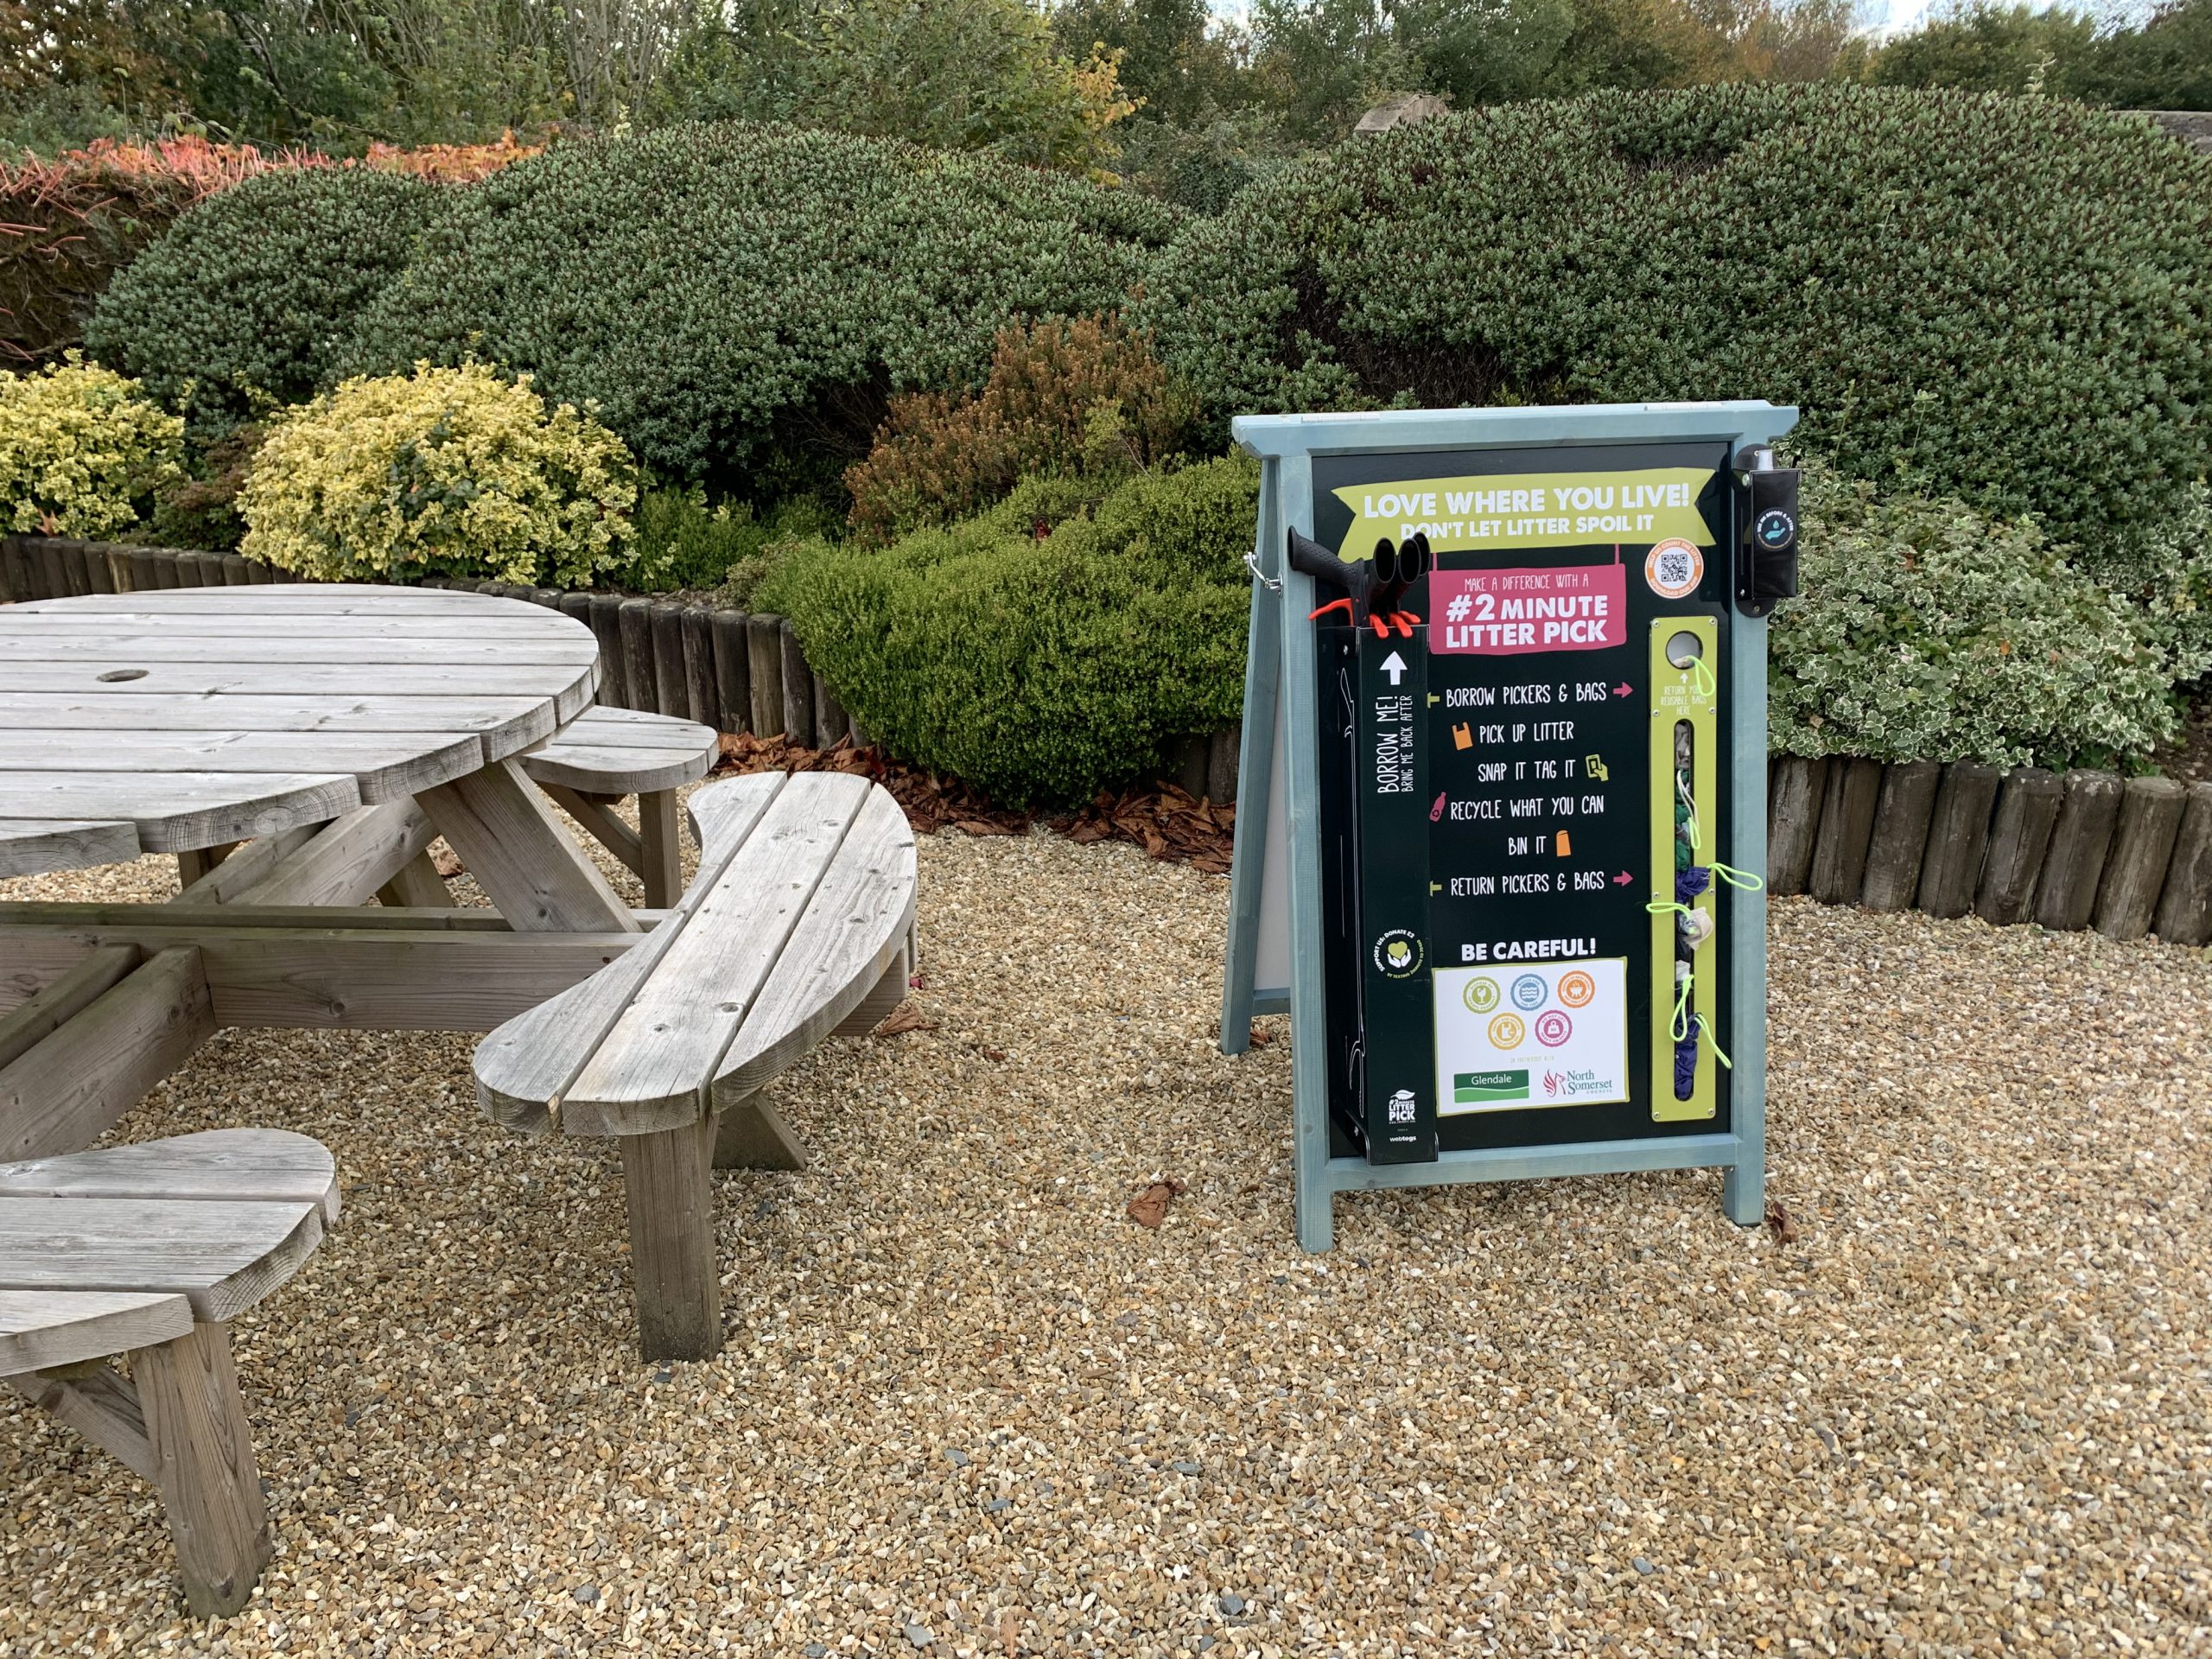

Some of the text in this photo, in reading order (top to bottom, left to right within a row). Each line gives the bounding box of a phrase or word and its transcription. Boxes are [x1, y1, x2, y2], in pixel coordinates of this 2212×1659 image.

[1364, 483, 1689, 518] LOVE WHERE YOU LIVE!
[1401, 515, 1654, 540] DON'T LET LITTER SPOIL IT
[1465, 573, 1589, 592] MAKE A DIFFERENCE WITH A
[1446, 594, 1608, 622] #2 MINUTE
[1446, 620, 1608, 648] LITTER PICK
[1446, 682, 1607, 707] BORROW PICKERS & BAGS
[1376, 696, 1399, 793] BORROW ME!
[1400, 695, 1414, 792] BRING ME BACK AFTER
[1479, 721, 1574, 744] PICK UP LITTER
[1478, 760, 1576, 782] SNAP IT TAG IT
[1451, 795, 1604, 820] RECYCLE WHAT YOU CAN
[1508, 836, 1546, 855] BIN IT
[1451, 871, 1604, 896] RETURN PICKERS & BAGS
[1374, 945, 1385, 971] SUPPORT
[1384, 929, 1407, 938] DONATE
[1462, 938, 1596, 961] BE CAREFUL!
[1471, 1074, 1512, 1086] Glendale
[1567, 1069, 1594, 1081] North
[1568, 1080, 1612, 1095] Somerset
[1389, 1110, 1416, 1121] PICK
